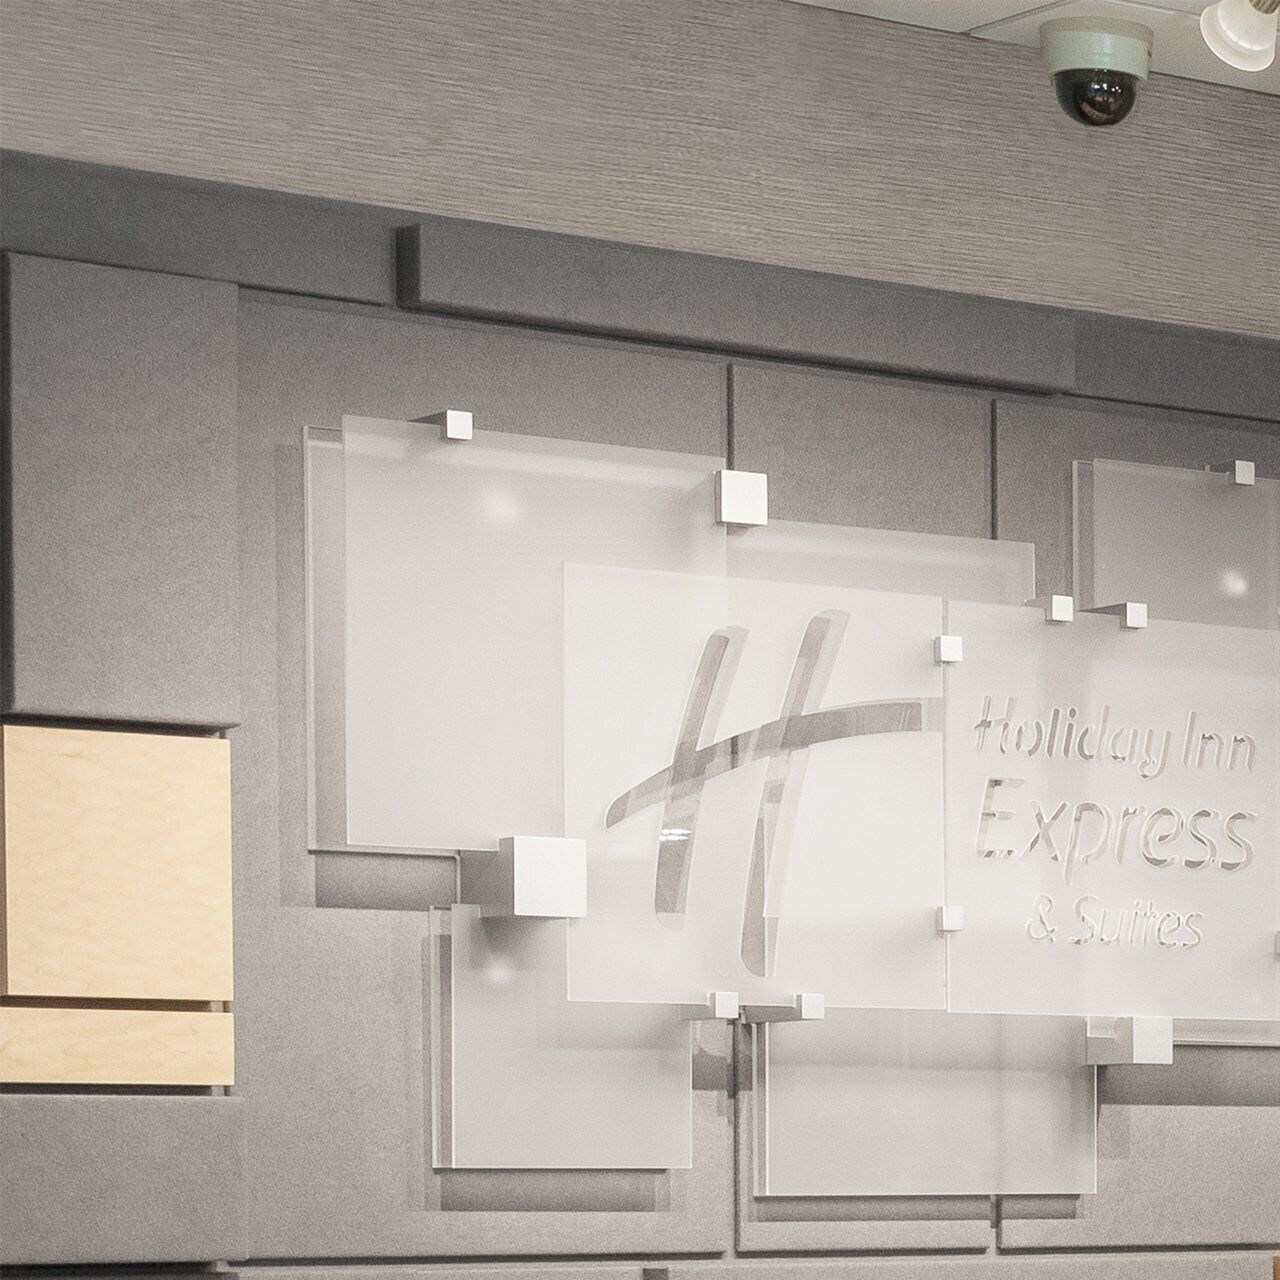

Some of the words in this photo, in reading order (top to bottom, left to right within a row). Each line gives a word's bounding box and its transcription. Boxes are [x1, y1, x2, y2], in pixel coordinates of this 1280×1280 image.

[973, 694, 1172, 780] Holiday
[1181, 710, 1256, 773] Inn
[973, 775, 1258, 886] Express
[1026, 893, 1057, 944] &
[1071, 894, 1205, 949] Suites
